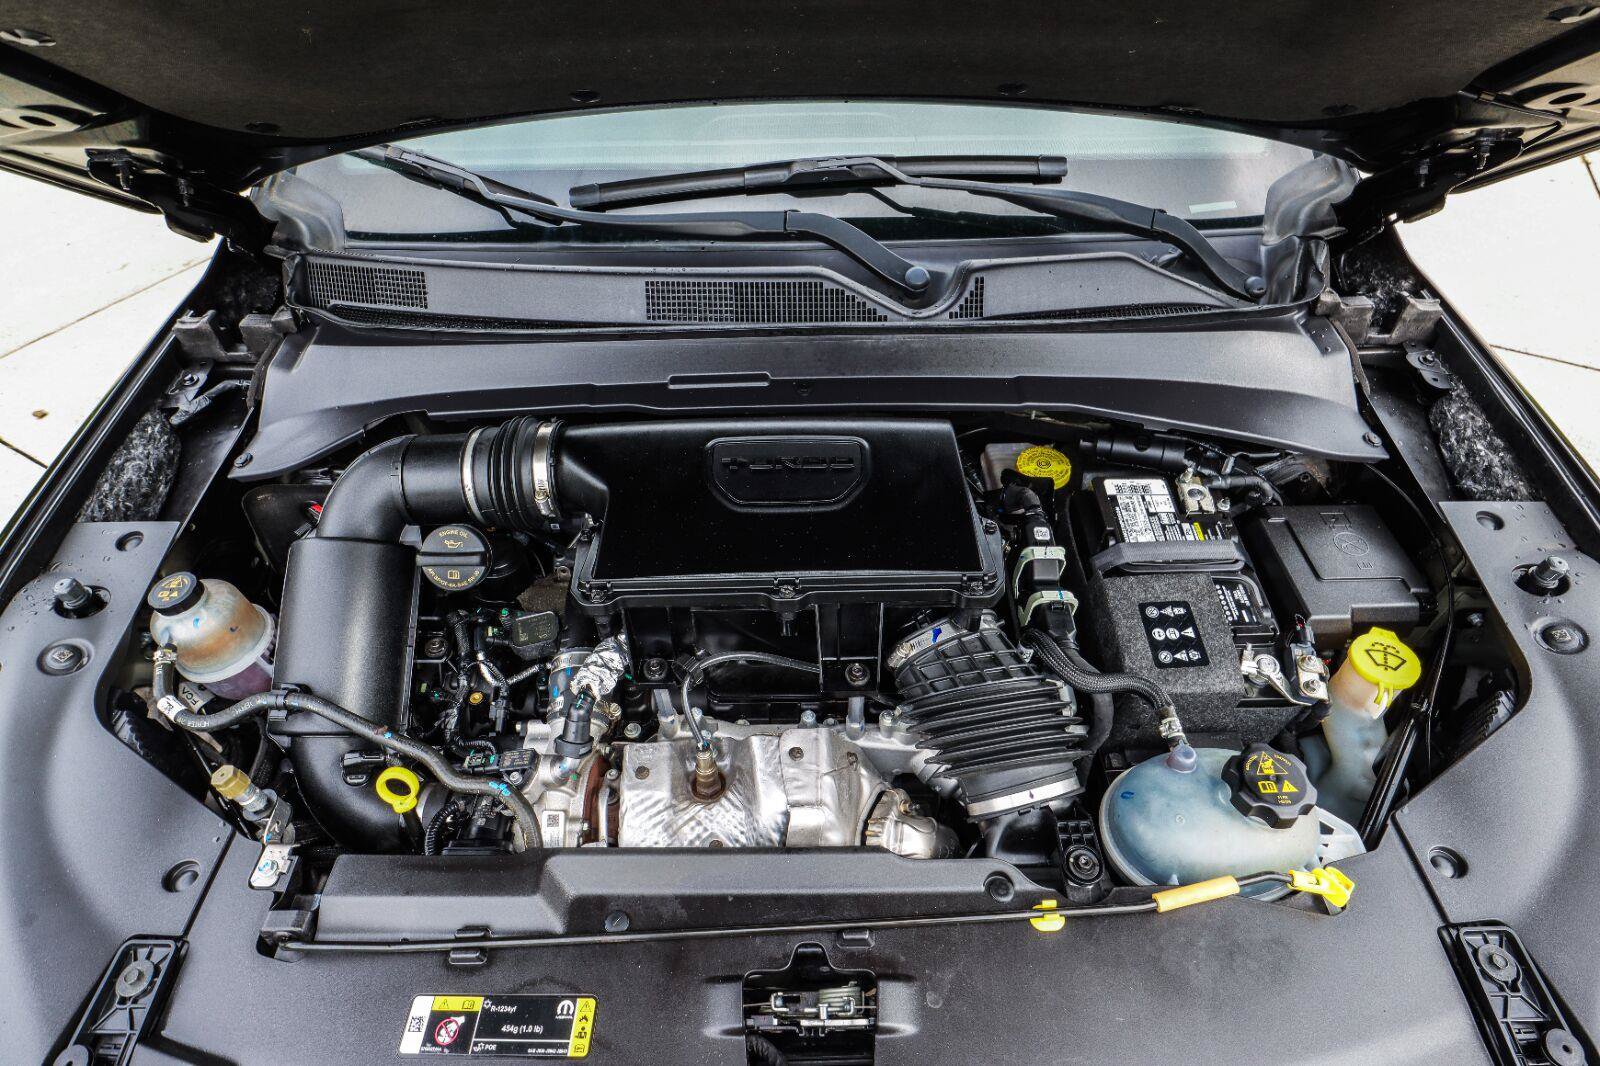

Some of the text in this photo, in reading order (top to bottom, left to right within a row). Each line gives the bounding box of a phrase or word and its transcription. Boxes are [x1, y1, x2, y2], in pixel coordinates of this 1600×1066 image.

[181, 686, 199, 706] FCA
[490, 1005, 517, 1014] R-1234yf
[501, 1024, 544, 1035] 454g (1.0 lb)
